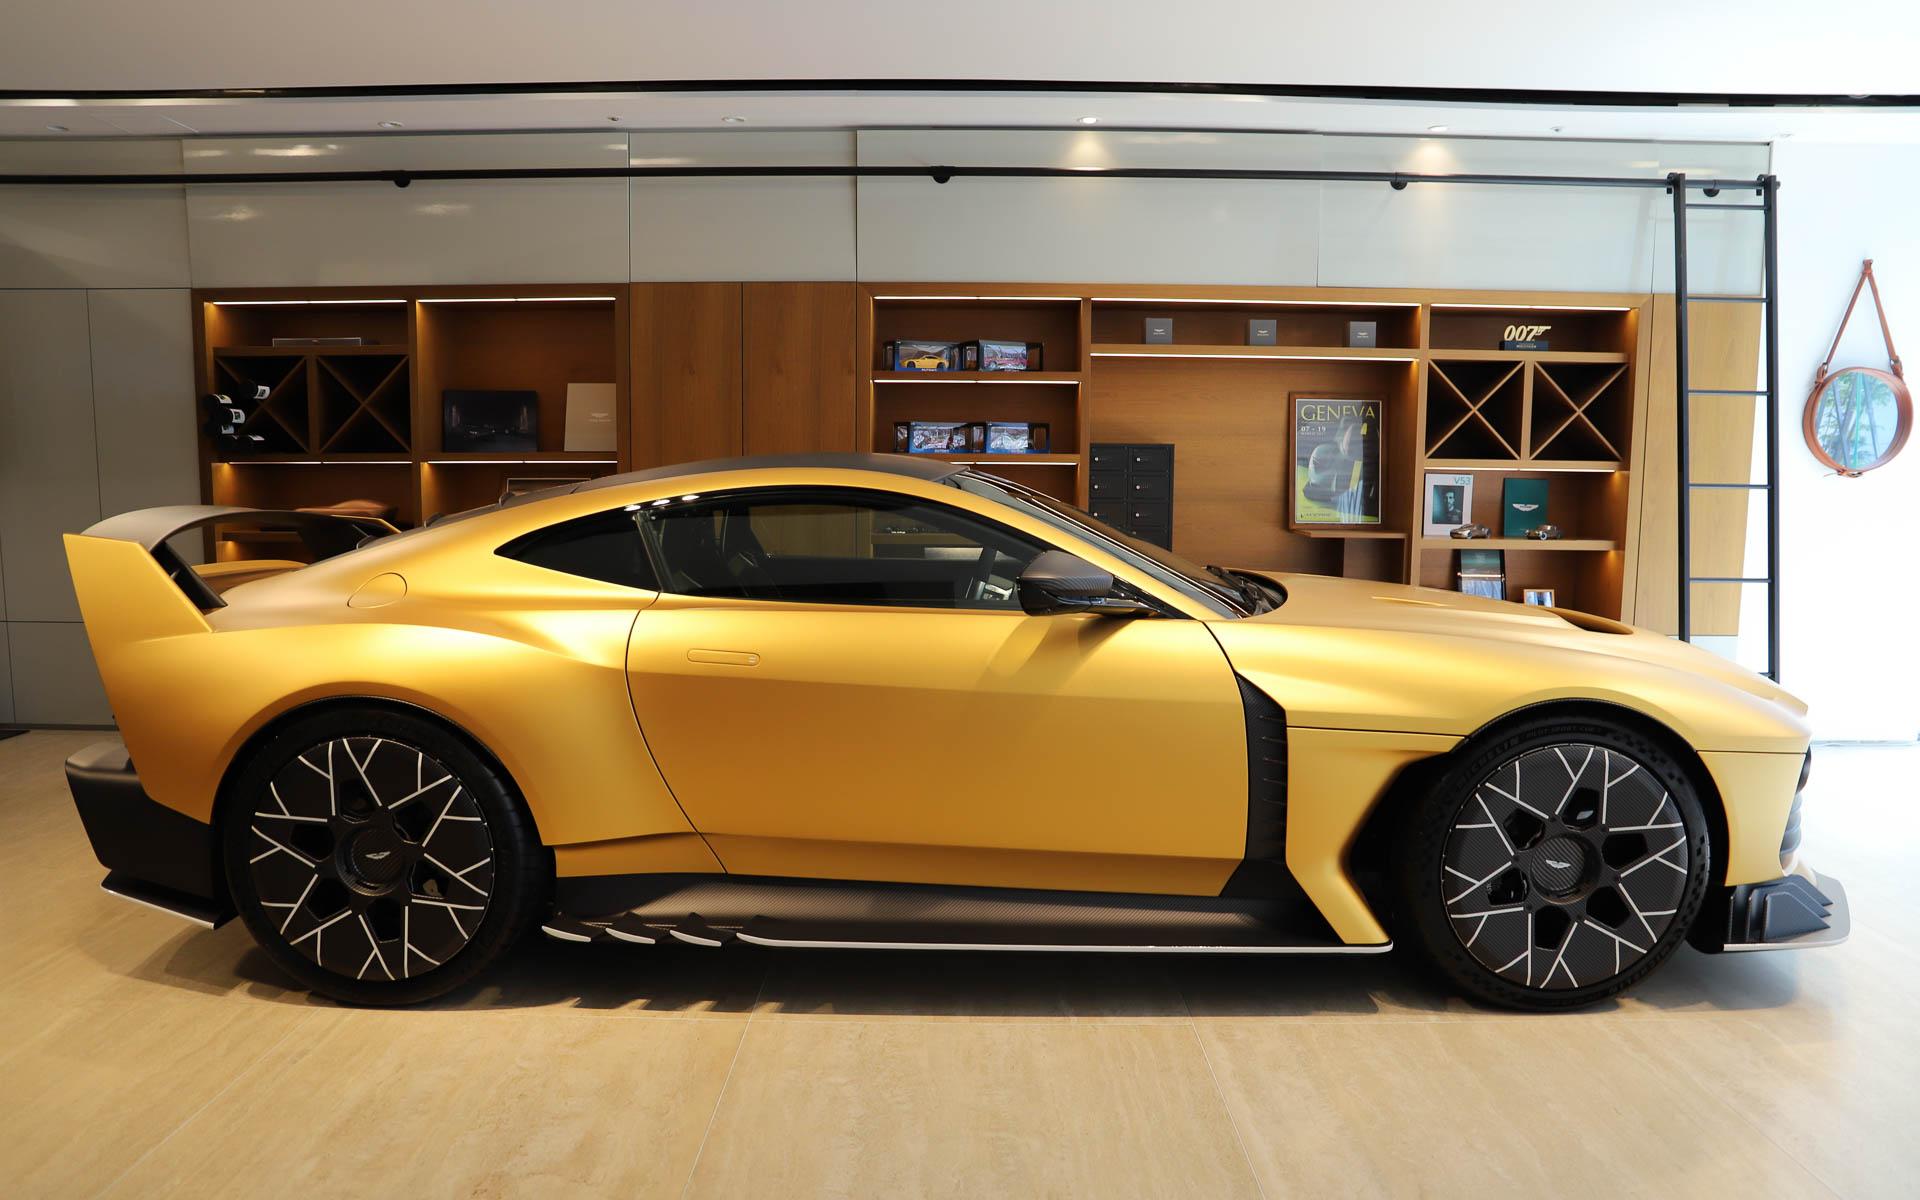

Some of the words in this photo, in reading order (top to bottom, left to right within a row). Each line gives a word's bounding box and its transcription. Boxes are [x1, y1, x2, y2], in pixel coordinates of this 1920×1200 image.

[1504, 325, 1539, 341] 007
[1301, 404, 1376, 421] GENEVA
[1454, 477, 1471, 485] V53
